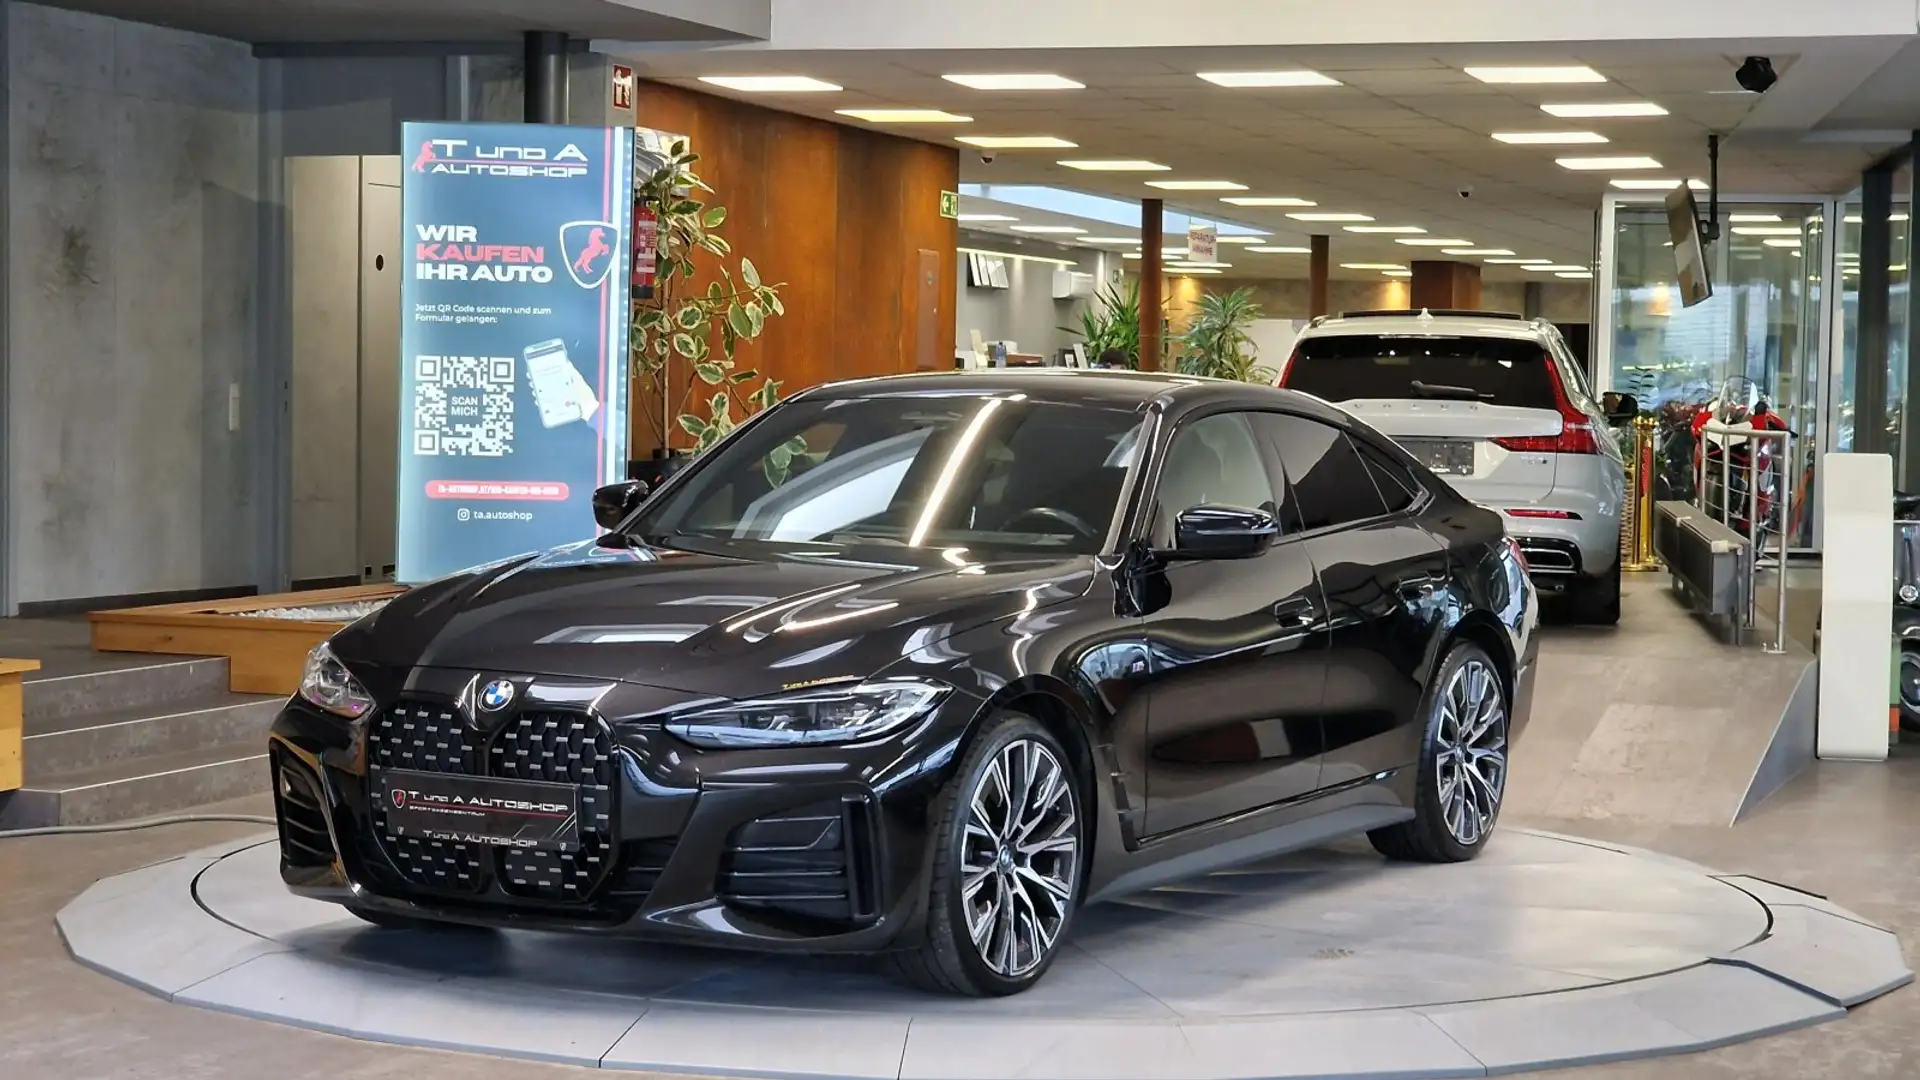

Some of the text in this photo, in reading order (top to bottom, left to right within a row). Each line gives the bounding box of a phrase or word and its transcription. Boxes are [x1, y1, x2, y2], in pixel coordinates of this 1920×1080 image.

[432, 139, 468, 158] T
[553, 143, 588, 162] A
[431, 163, 588, 178] AUTOSHOP
[416, 224, 478, 242] WIR
[416, 243, 545, 263] KAUFEN
[416, 262, 554, 284] IHR AUTO
[415, 303, 552, 315] Jetzt QR Code scannen und zum
[415, 313, 498, 325] Formular gelangen:
[451, 396, 478, 406] SCAN
[450, 406, 478, 417] MICH
[473, 511, 533, 522] ta.autoshop
[408, 790, 420, 800] T
[452, 796, 465, 804] A
[469, 797, 569, 812] AUTOSHOP
[423, 830, 433, 838] T
[450, 833, 460, 841] A
[464, 834, 538, 848] AUTOSHOP
